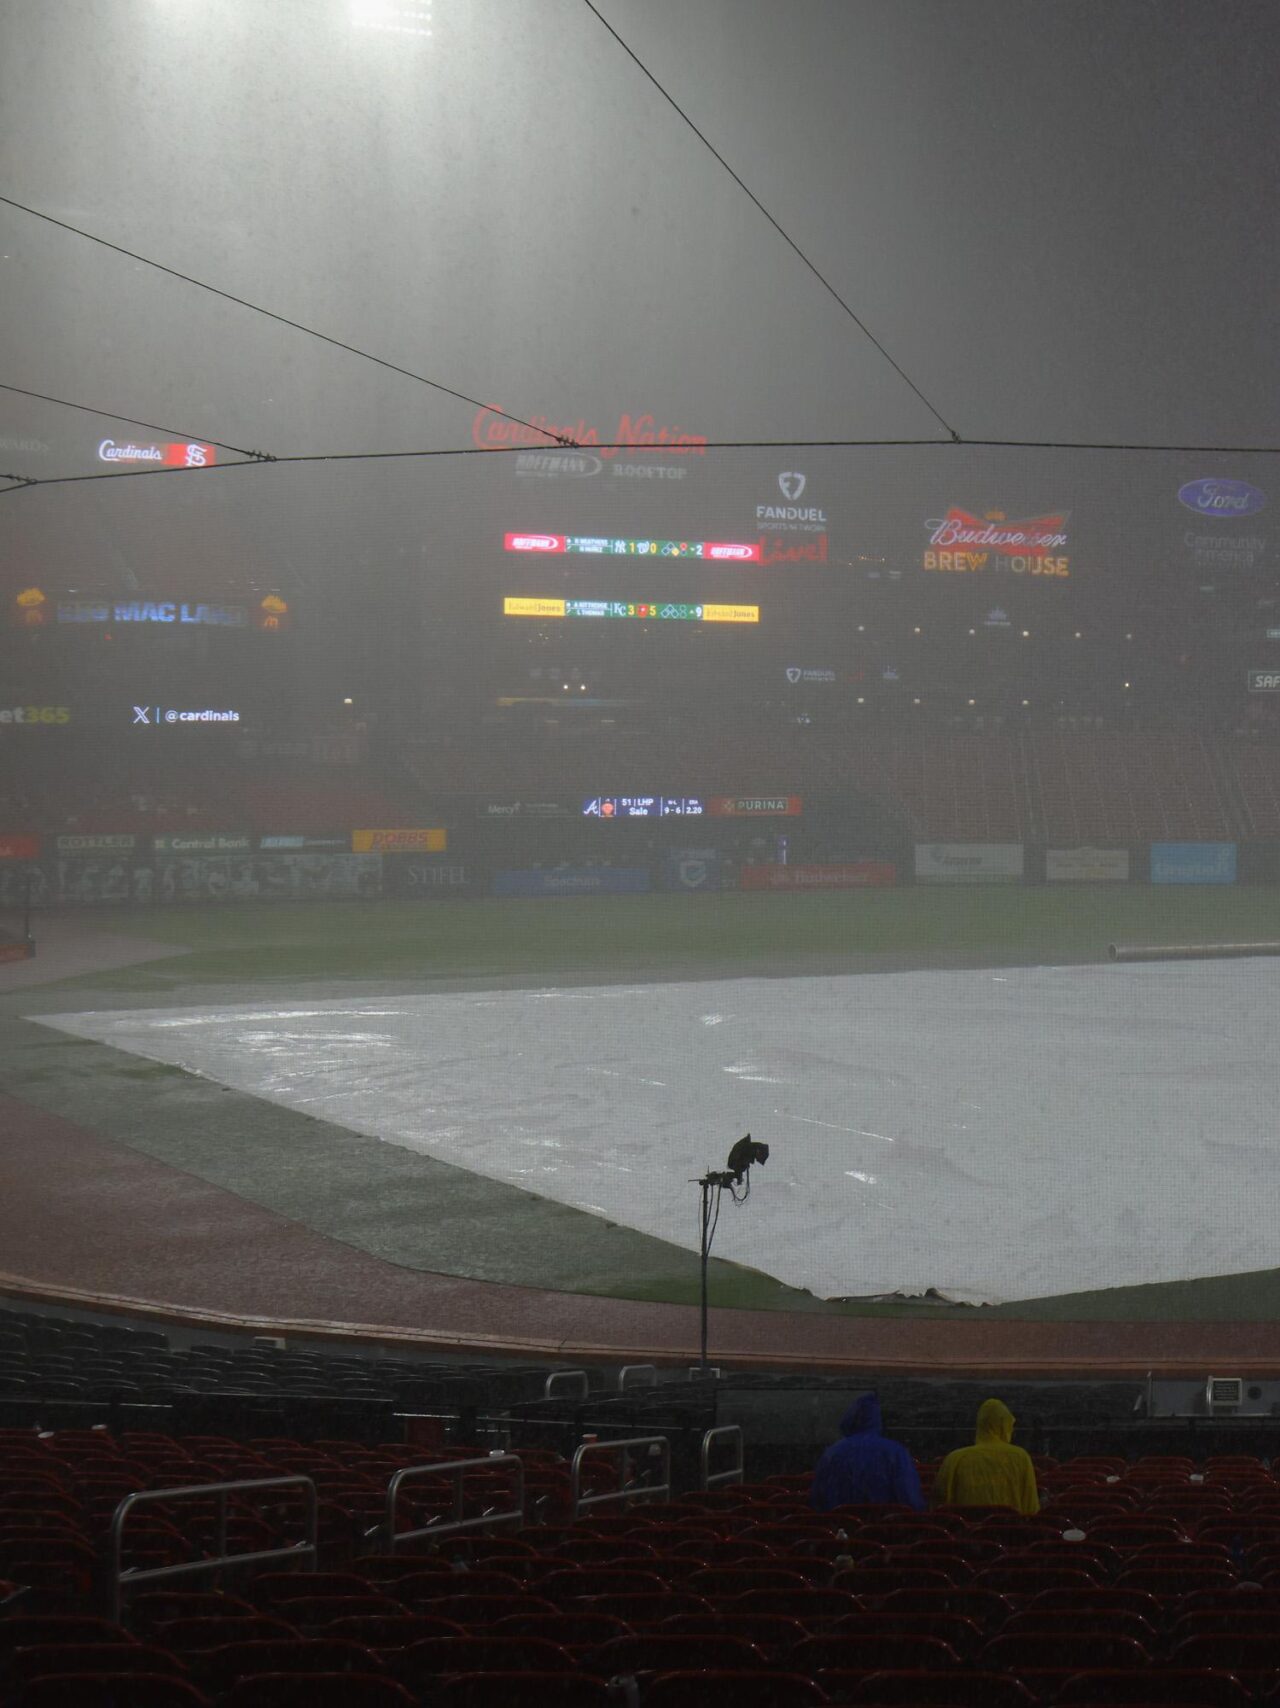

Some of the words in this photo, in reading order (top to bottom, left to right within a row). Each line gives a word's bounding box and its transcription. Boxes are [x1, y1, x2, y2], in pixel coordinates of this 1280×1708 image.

[471, 403, 599, 450] Cardinals
[600, 413, 709, 459] Nation
[99, 439, 162, 461] Cardinals
[1197, 483, 1250, 509] Ford
[756, 505, 827, 522] FANDUEL
[630, 542, 636, 553] 1
[650, 543, 657, 554] 0
[696, 545, 703, 556] 2
[924, 551, 989, 572] BREW
[995, 555, 1070, 576] HOUSE
[628, 604, 636, 616] 3
[649, 605, 657, 617] 5
[695, 606, 703, 618] 9
[165, 709, 240, 723] @cardinals
[622, 798, 632, 806] 51
[638, 798, 654, 806] LHP
[737, 799, 785, 811] PURINA
[629, 807, 648, 816] Sale
[408, 864, 471, 886] STIFEL
